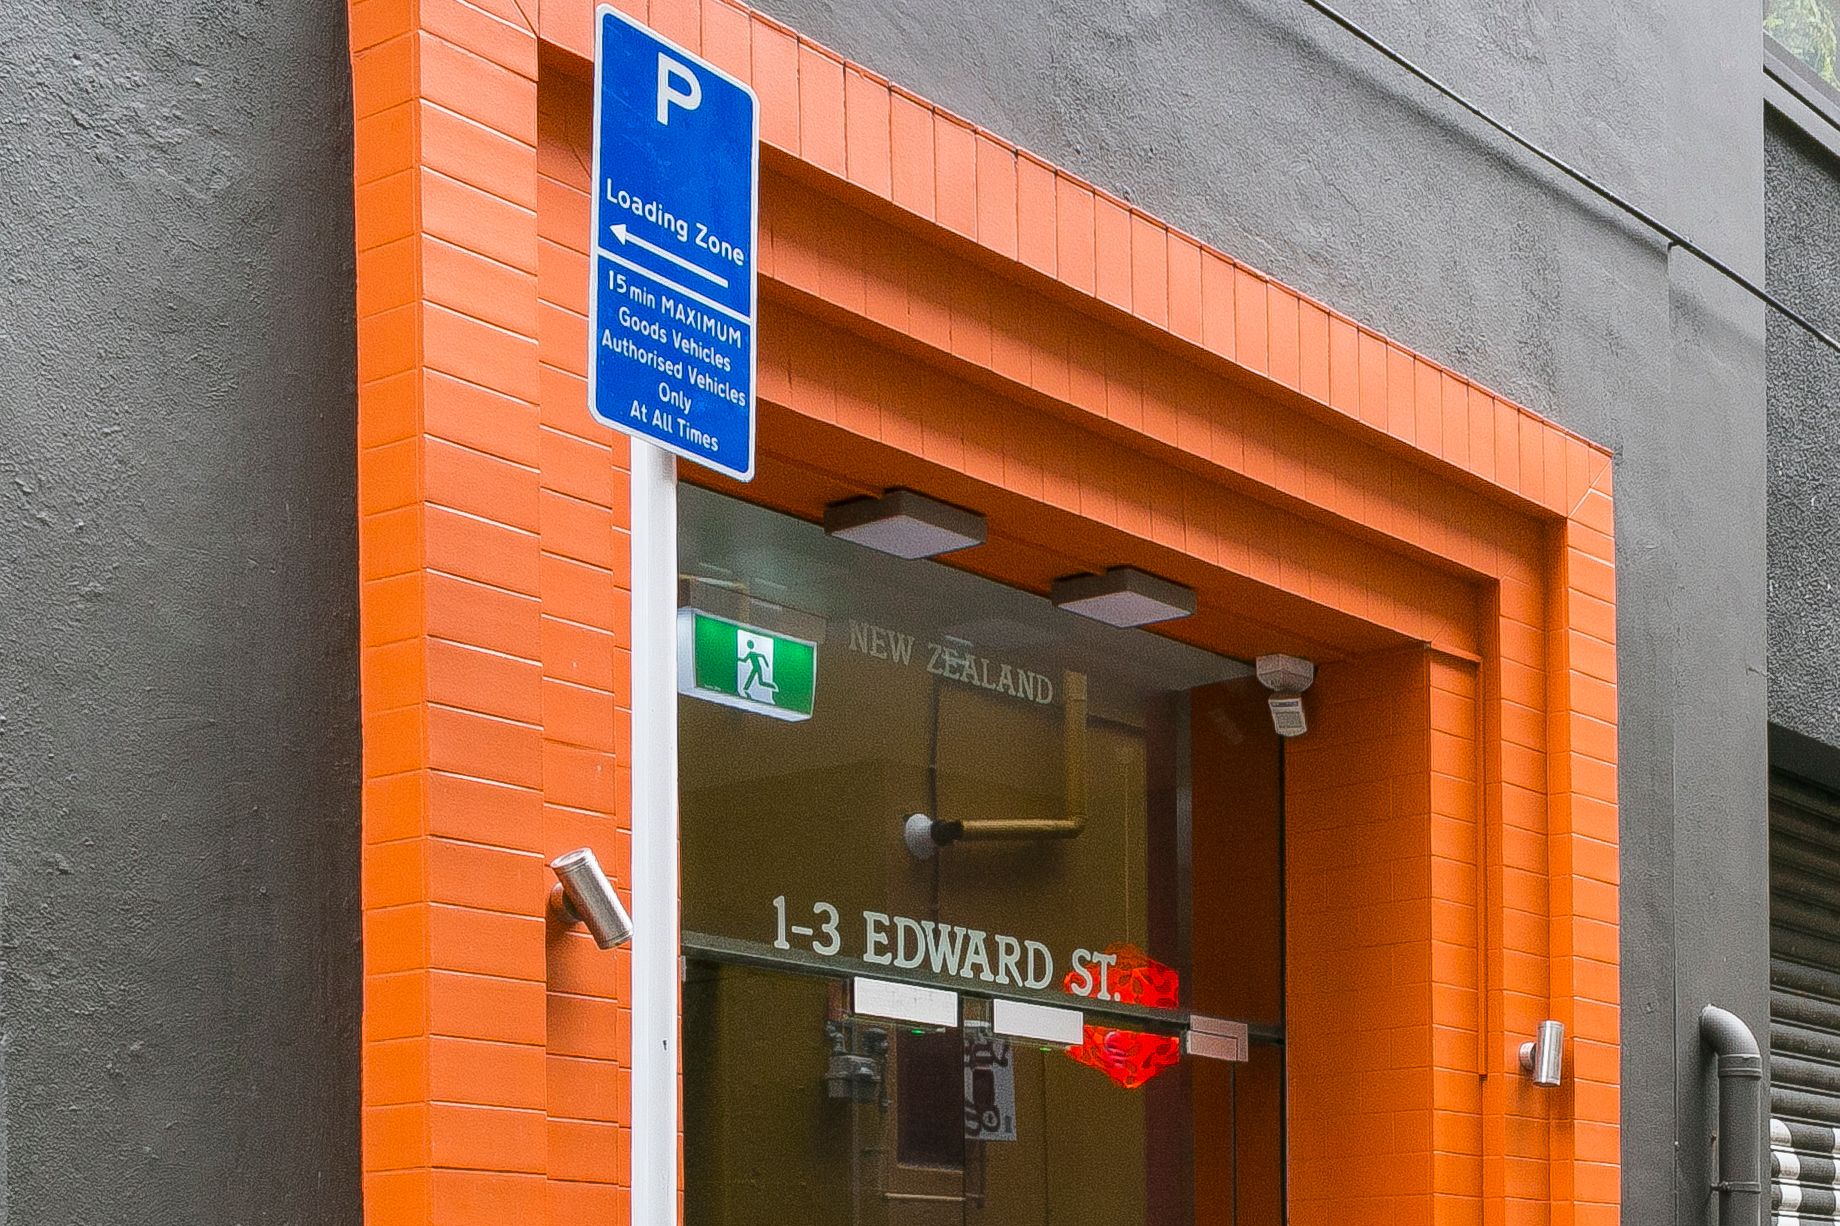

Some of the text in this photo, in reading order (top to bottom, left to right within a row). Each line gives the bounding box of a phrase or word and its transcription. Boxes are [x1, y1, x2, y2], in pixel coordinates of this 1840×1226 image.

[657, 51, 702, 126] P
[606, 177, 745, 266] Loading Zone
[608, 270, 742, 349] 15 min MAXIMUM
[618, 306, 731, 372] Goods Vehicles
[601, 328, 746, 407] Authorised Vehicles
[658, 382, 692, 415] Only
[630, 399, 719, 452] At All Times
[849, 619, 1054, 705] NEW ZEALAND
[772, 894, 1122, 1001] 1-3 EDWARD ST.
